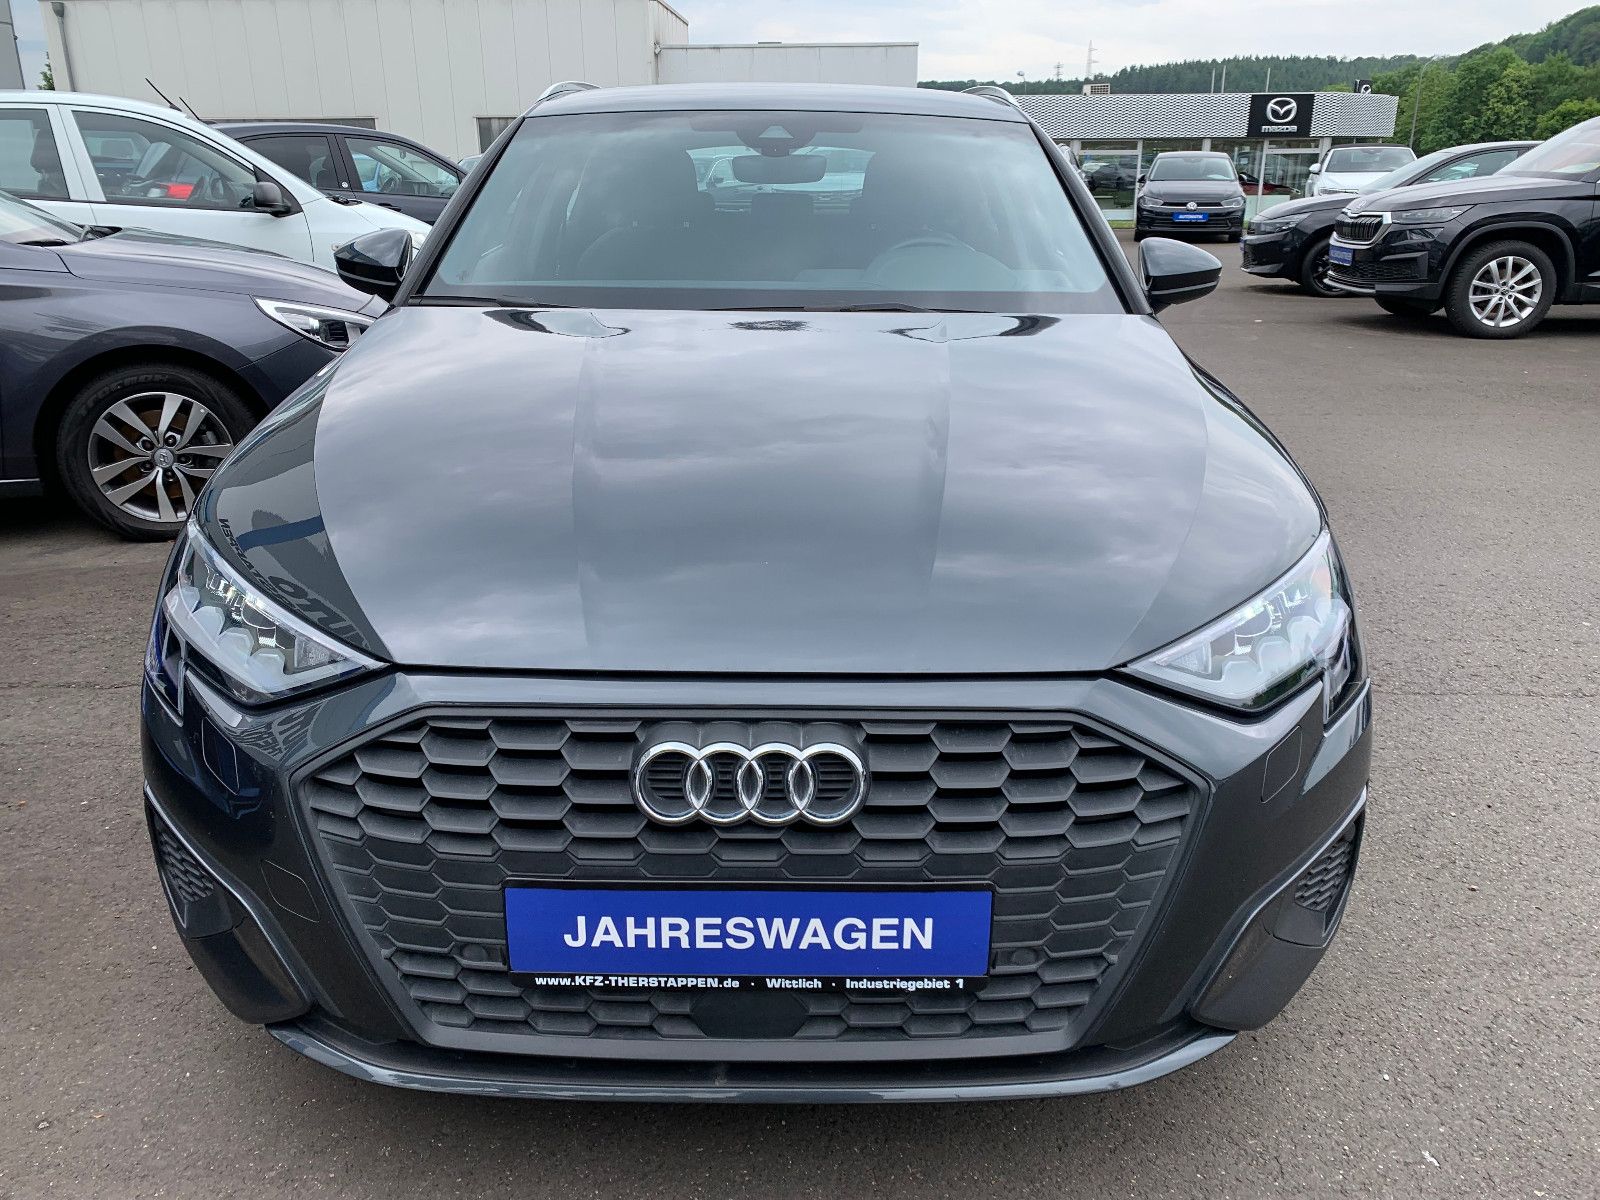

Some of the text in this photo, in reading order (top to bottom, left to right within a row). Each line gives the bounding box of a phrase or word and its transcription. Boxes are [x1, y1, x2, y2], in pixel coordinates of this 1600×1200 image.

[1261, 125, 1298, 133] mazda
[564, 915, 934, 951] JAHRESWAGEN
[535, 976, 964, 992] www.KFZ-THERSTAPPEN.de Wittlich Industriegebiet 1
